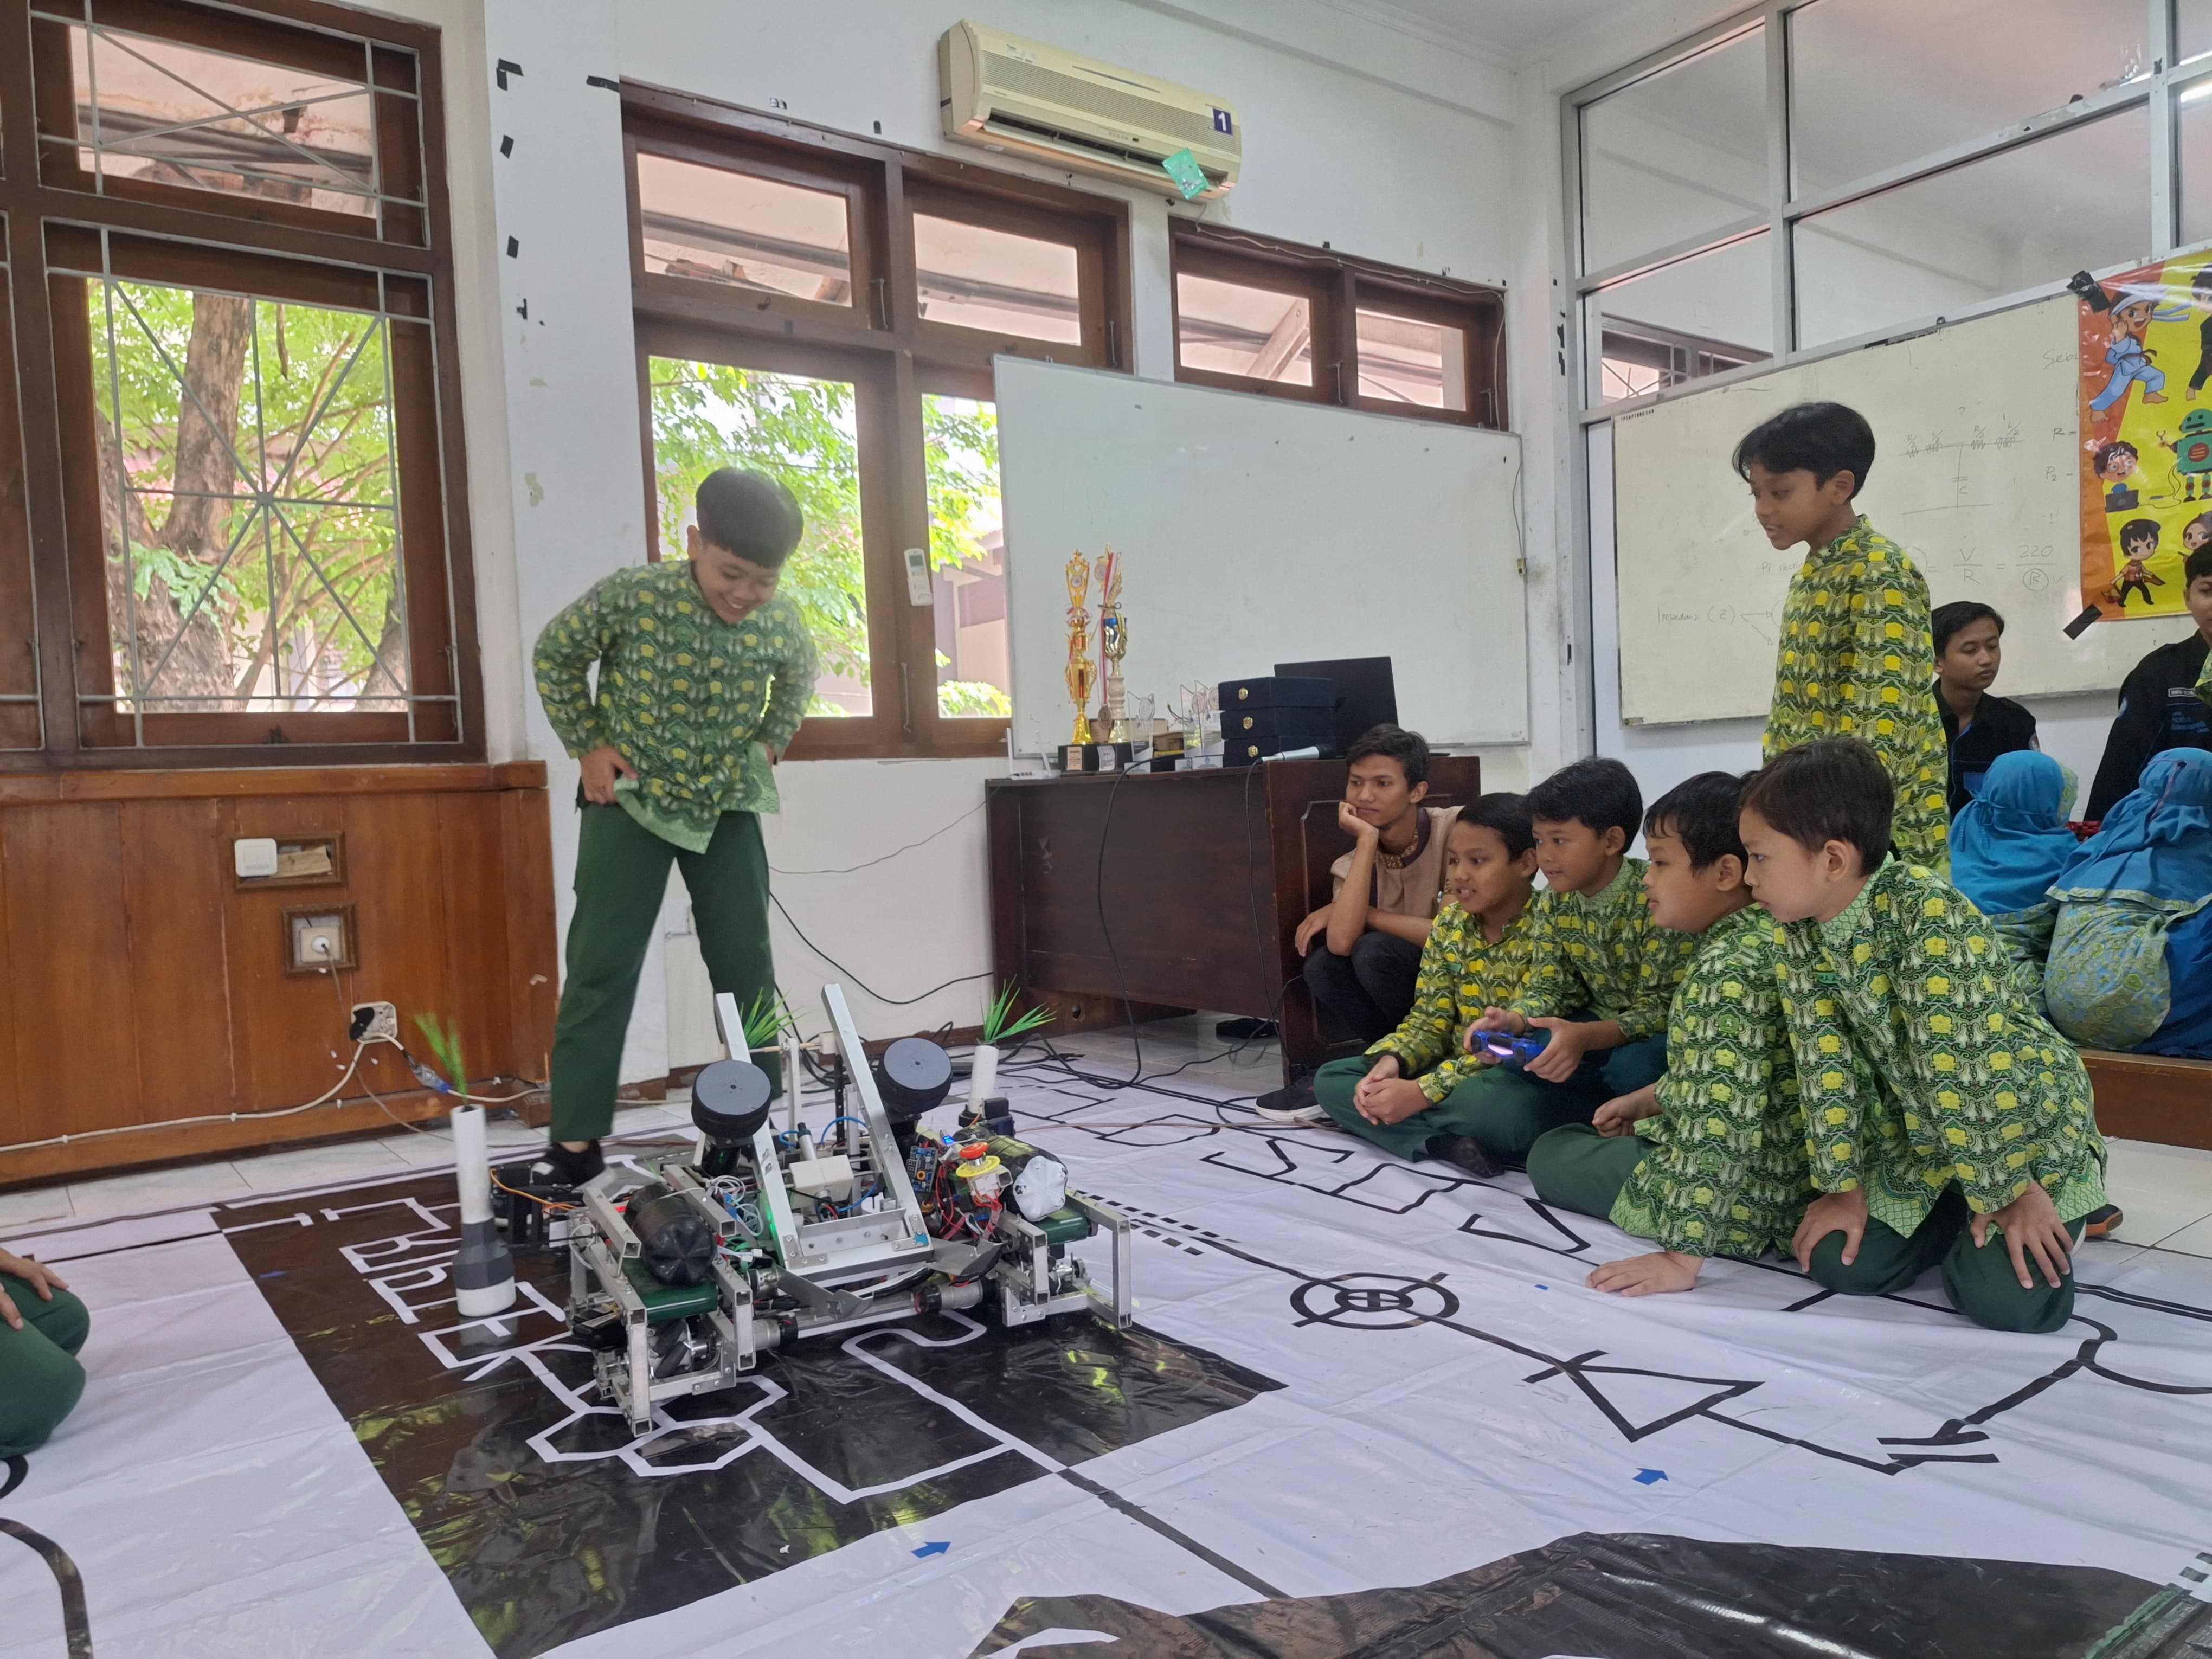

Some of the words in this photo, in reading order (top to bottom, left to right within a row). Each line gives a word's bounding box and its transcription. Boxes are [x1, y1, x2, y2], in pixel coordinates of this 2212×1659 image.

[1218, 112, 1227, 131] 1
[2018, 544, 2053, 558] 220
[1964, 568, 1982, 586] R
